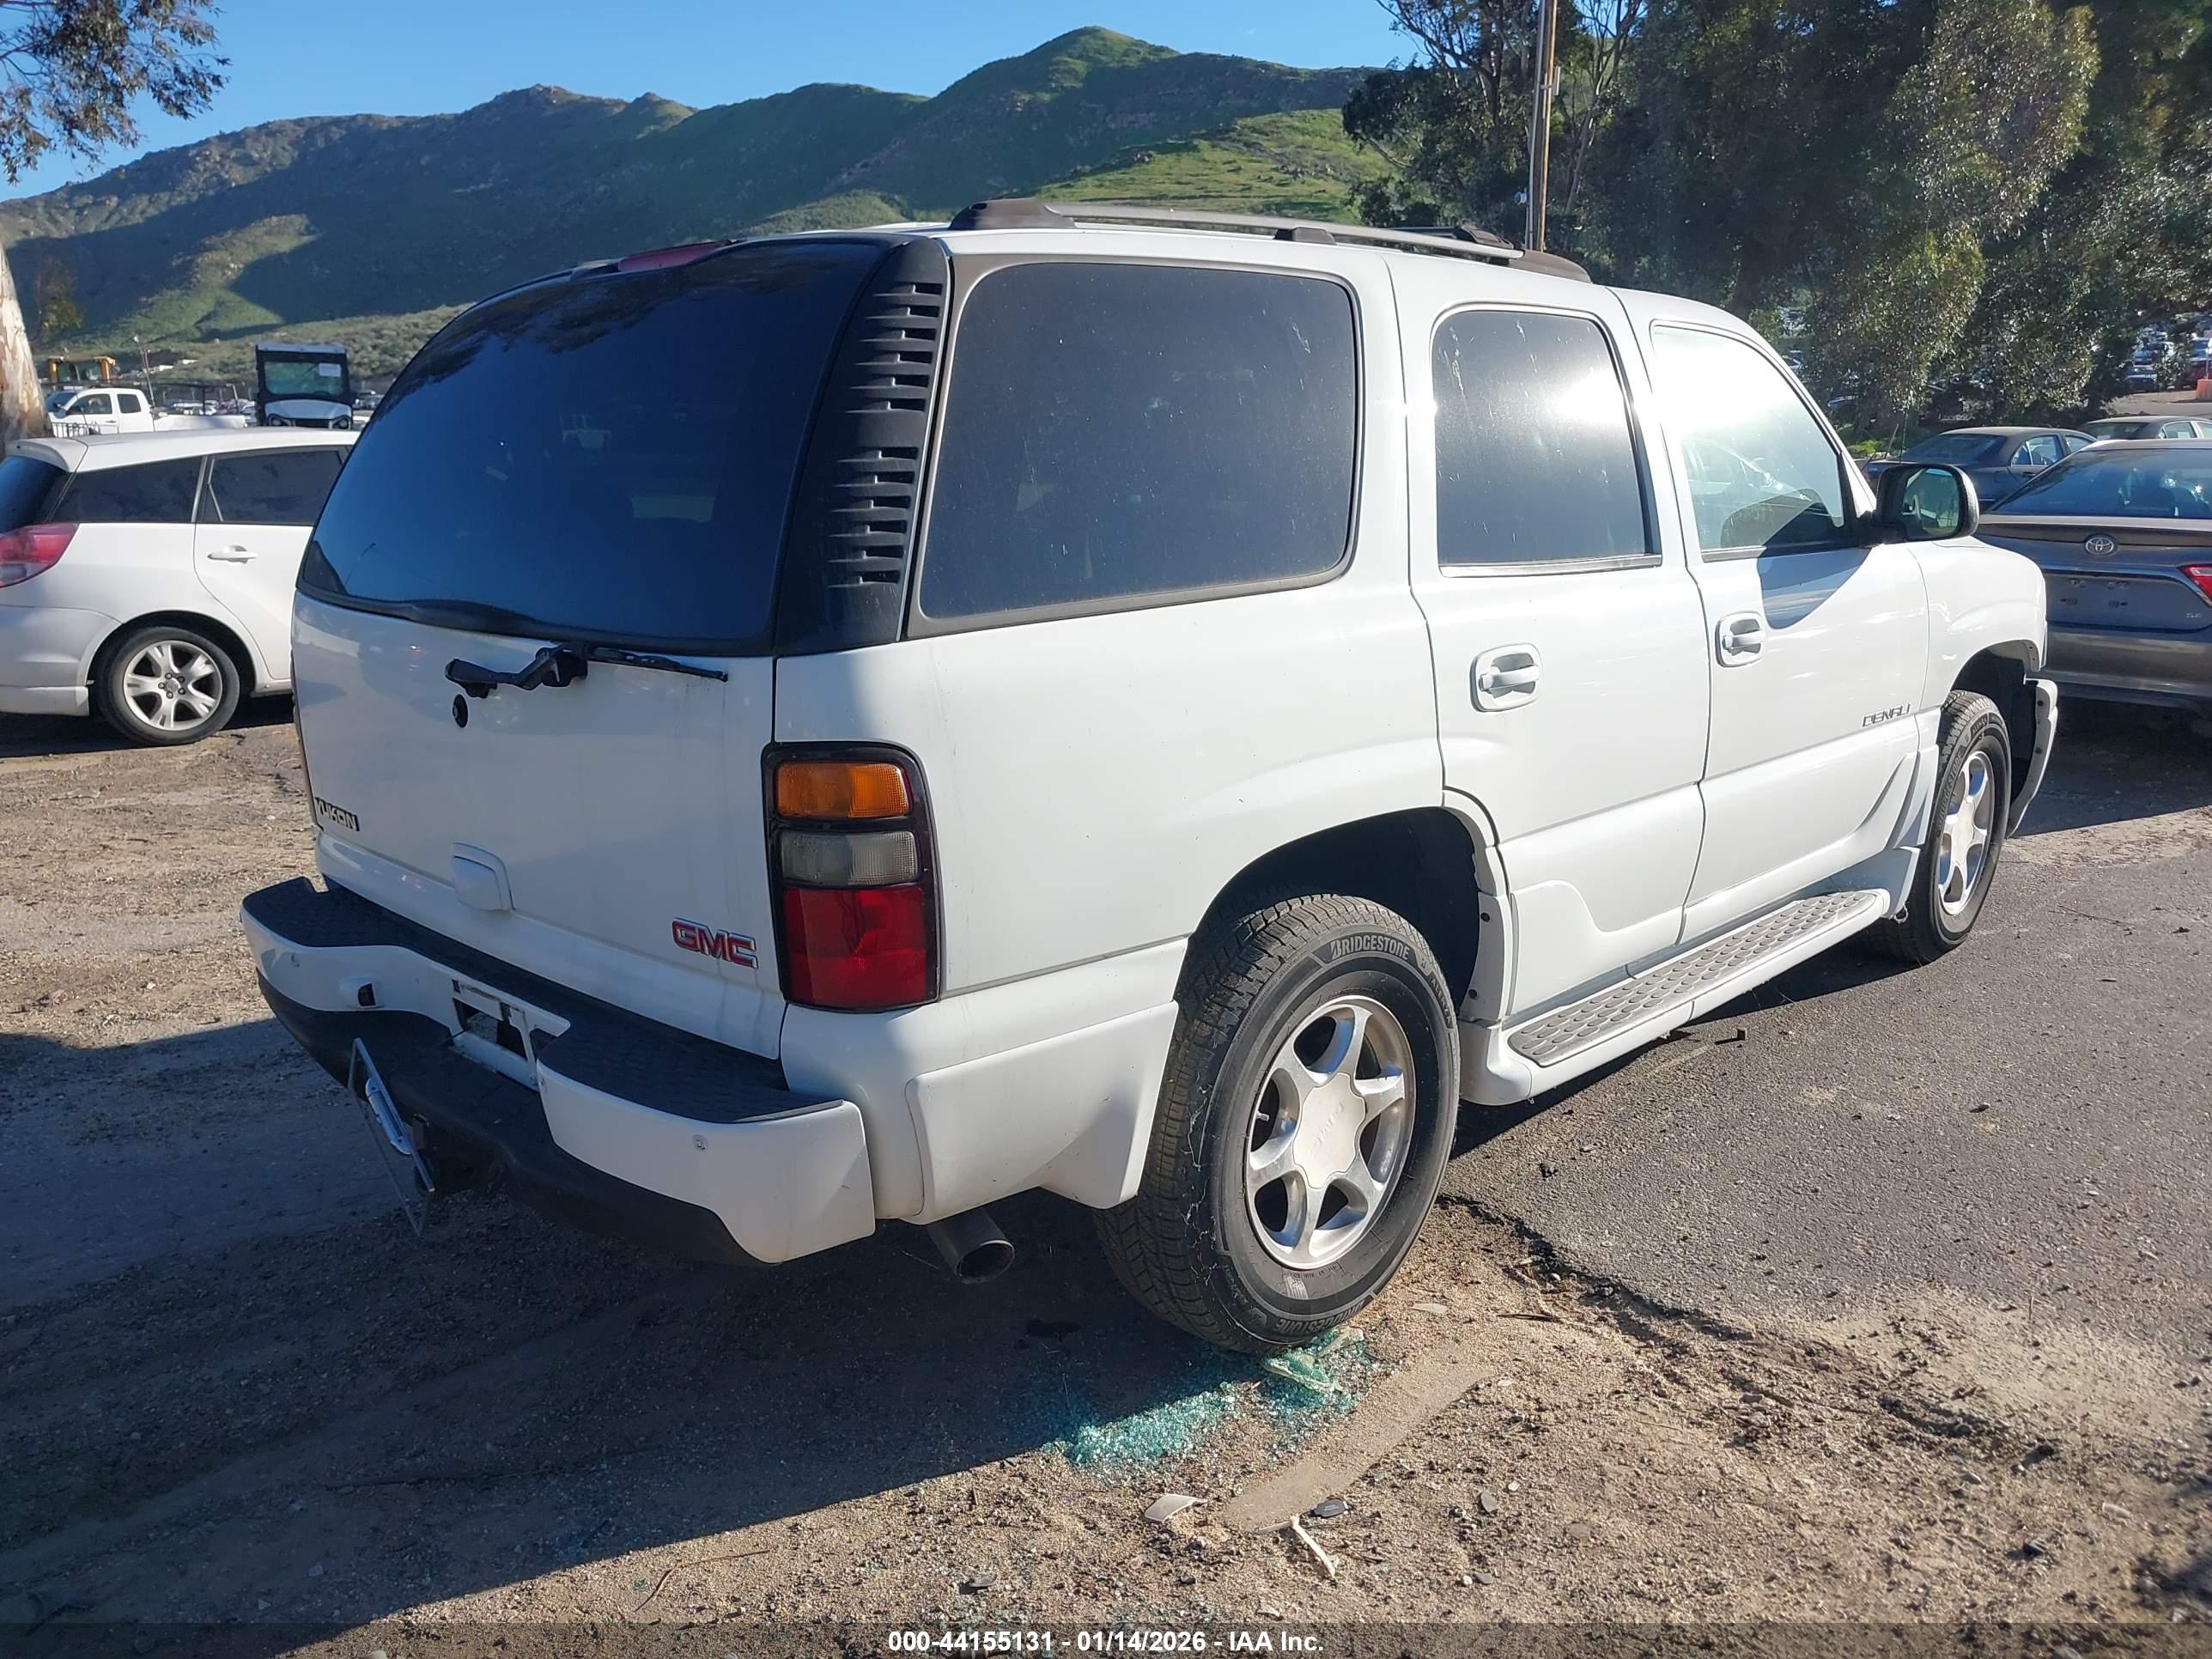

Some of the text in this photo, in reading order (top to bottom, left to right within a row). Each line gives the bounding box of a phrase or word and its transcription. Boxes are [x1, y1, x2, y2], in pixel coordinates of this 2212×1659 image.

[1862, 702, 1911, 727] DENALI
[314, 796, 360, 832] YUKON
[672, 916, 759, 969] GMC
[1330, 934, 1411, 961] BRIDGESTONE
